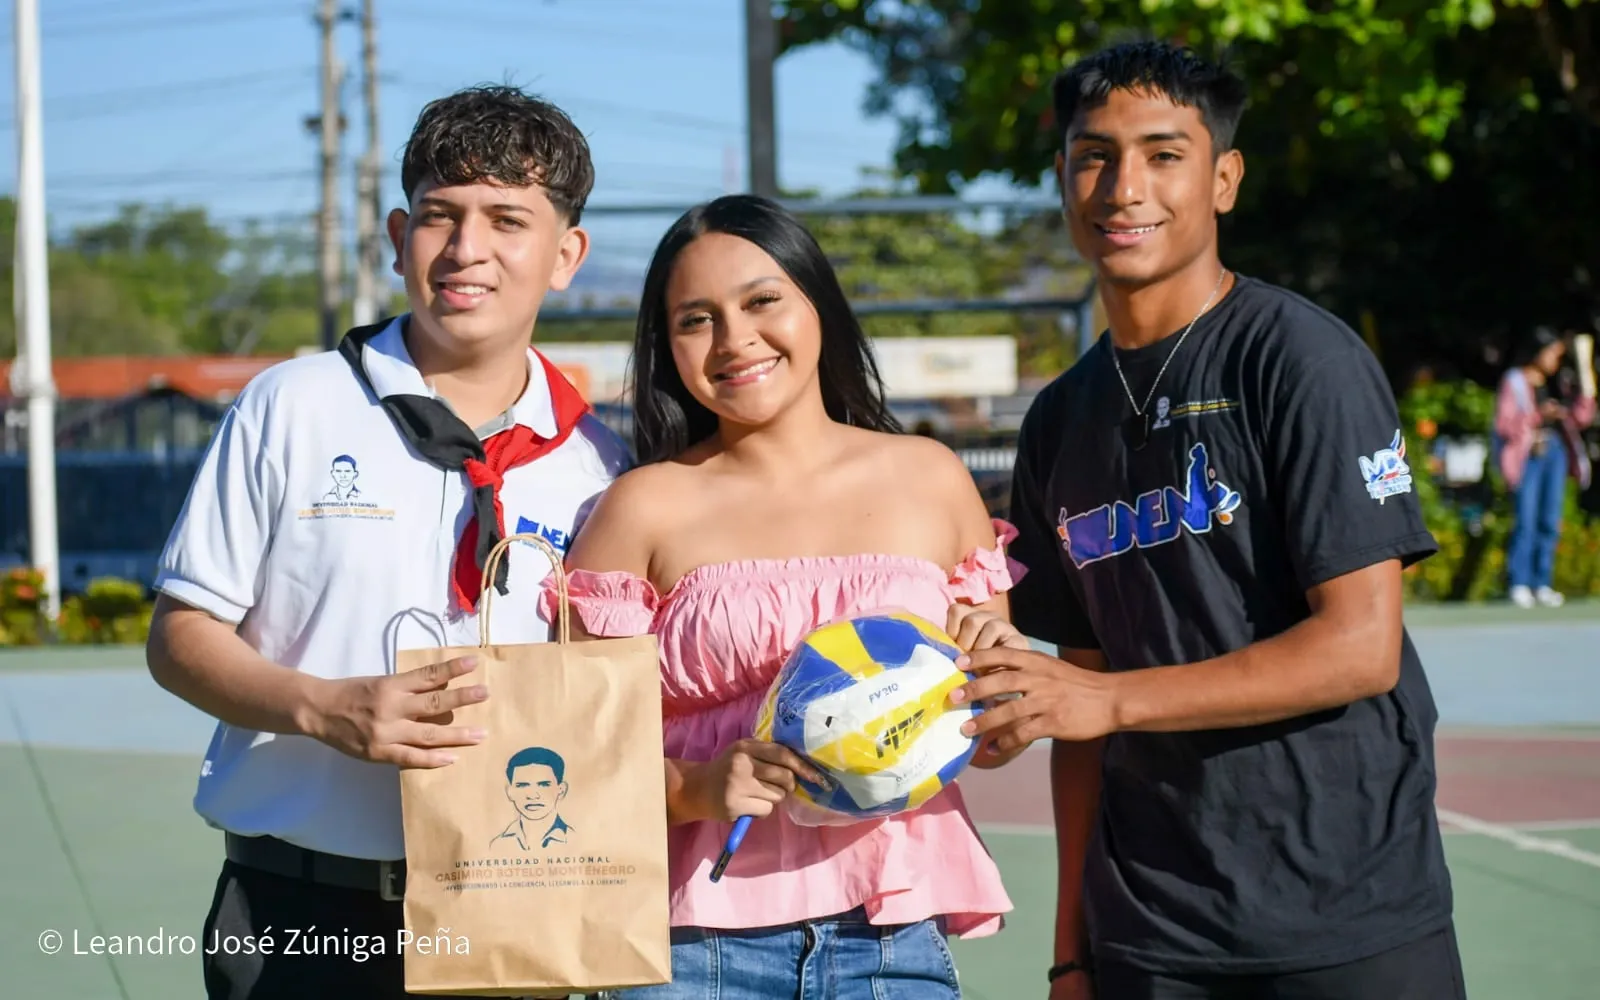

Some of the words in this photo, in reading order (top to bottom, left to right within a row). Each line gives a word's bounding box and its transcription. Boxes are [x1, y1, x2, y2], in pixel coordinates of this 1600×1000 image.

[455, 858, 540, 869] UNIVERSIDAD
[547, 856, 611, 865] NACIONAL
[435, 868, 493, 883] CASIMIRO
[497, 867, 545, 878] BOTELO
[548, 864, 636, 877] MONTENEGRO
